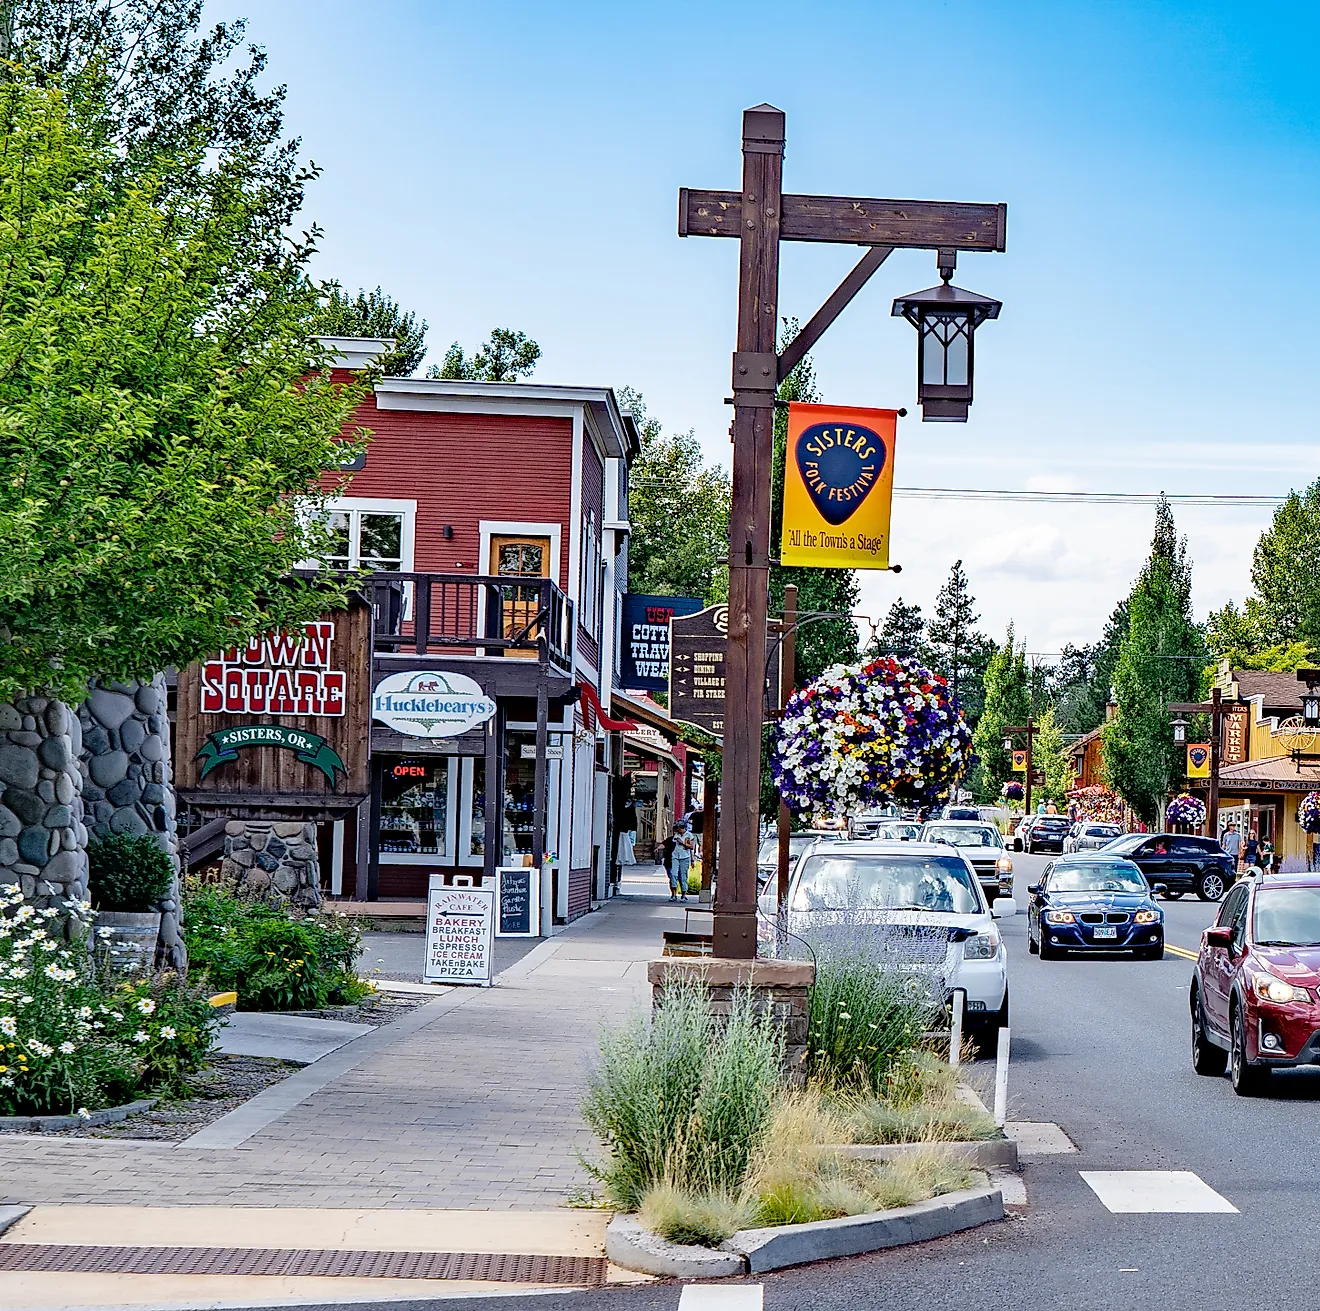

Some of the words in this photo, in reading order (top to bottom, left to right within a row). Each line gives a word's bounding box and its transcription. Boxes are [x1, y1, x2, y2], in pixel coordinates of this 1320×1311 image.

[806, 428, 876, 459] SISTERS
[805, 461, 827, 494] FOLK
[828, 464, 875, 502] FESTIVAL
[803, 530, 816, 547] the
[819, 531, 849, 549] Town's
[850, 538, 856, 549] a
[632, 624, 670, 641] COTT
[630, 642, 670, 660] TRAV
[693, 652, 723, 662] SHOPPING
[635, 660, 670, 677] WEA
[693, 665, 715, 674] DINING
[693, 677, 720, 686] VILLAGE
[201, 661, 346, 716] SQUARE
[693, 689, 704, 698] FIR
[705, 689, 726, 699] STREE
[375, 695, 485, 718] Hucklebearys
[228, 728, 285, 744] SISTERS,
[287, 733, 307, 749] OR
[1228, 714, 1242, 762] MARKET
[393, 765, 425, 777] OPEN
[434, 893, 488, 911] RAINWATER
[435, 918, 485, 927] BAKERY
[432, 926, 487, 935] BREAKFAST
[439, 935, 479, 943] LUNCH
[432, 943, 485, 952] ESPRESSO
[450, 951, 483, 959] CREAM
[430, 959, 485, 968] TAKEnBAKE
[440, 967, 473, 975] PIZZA
